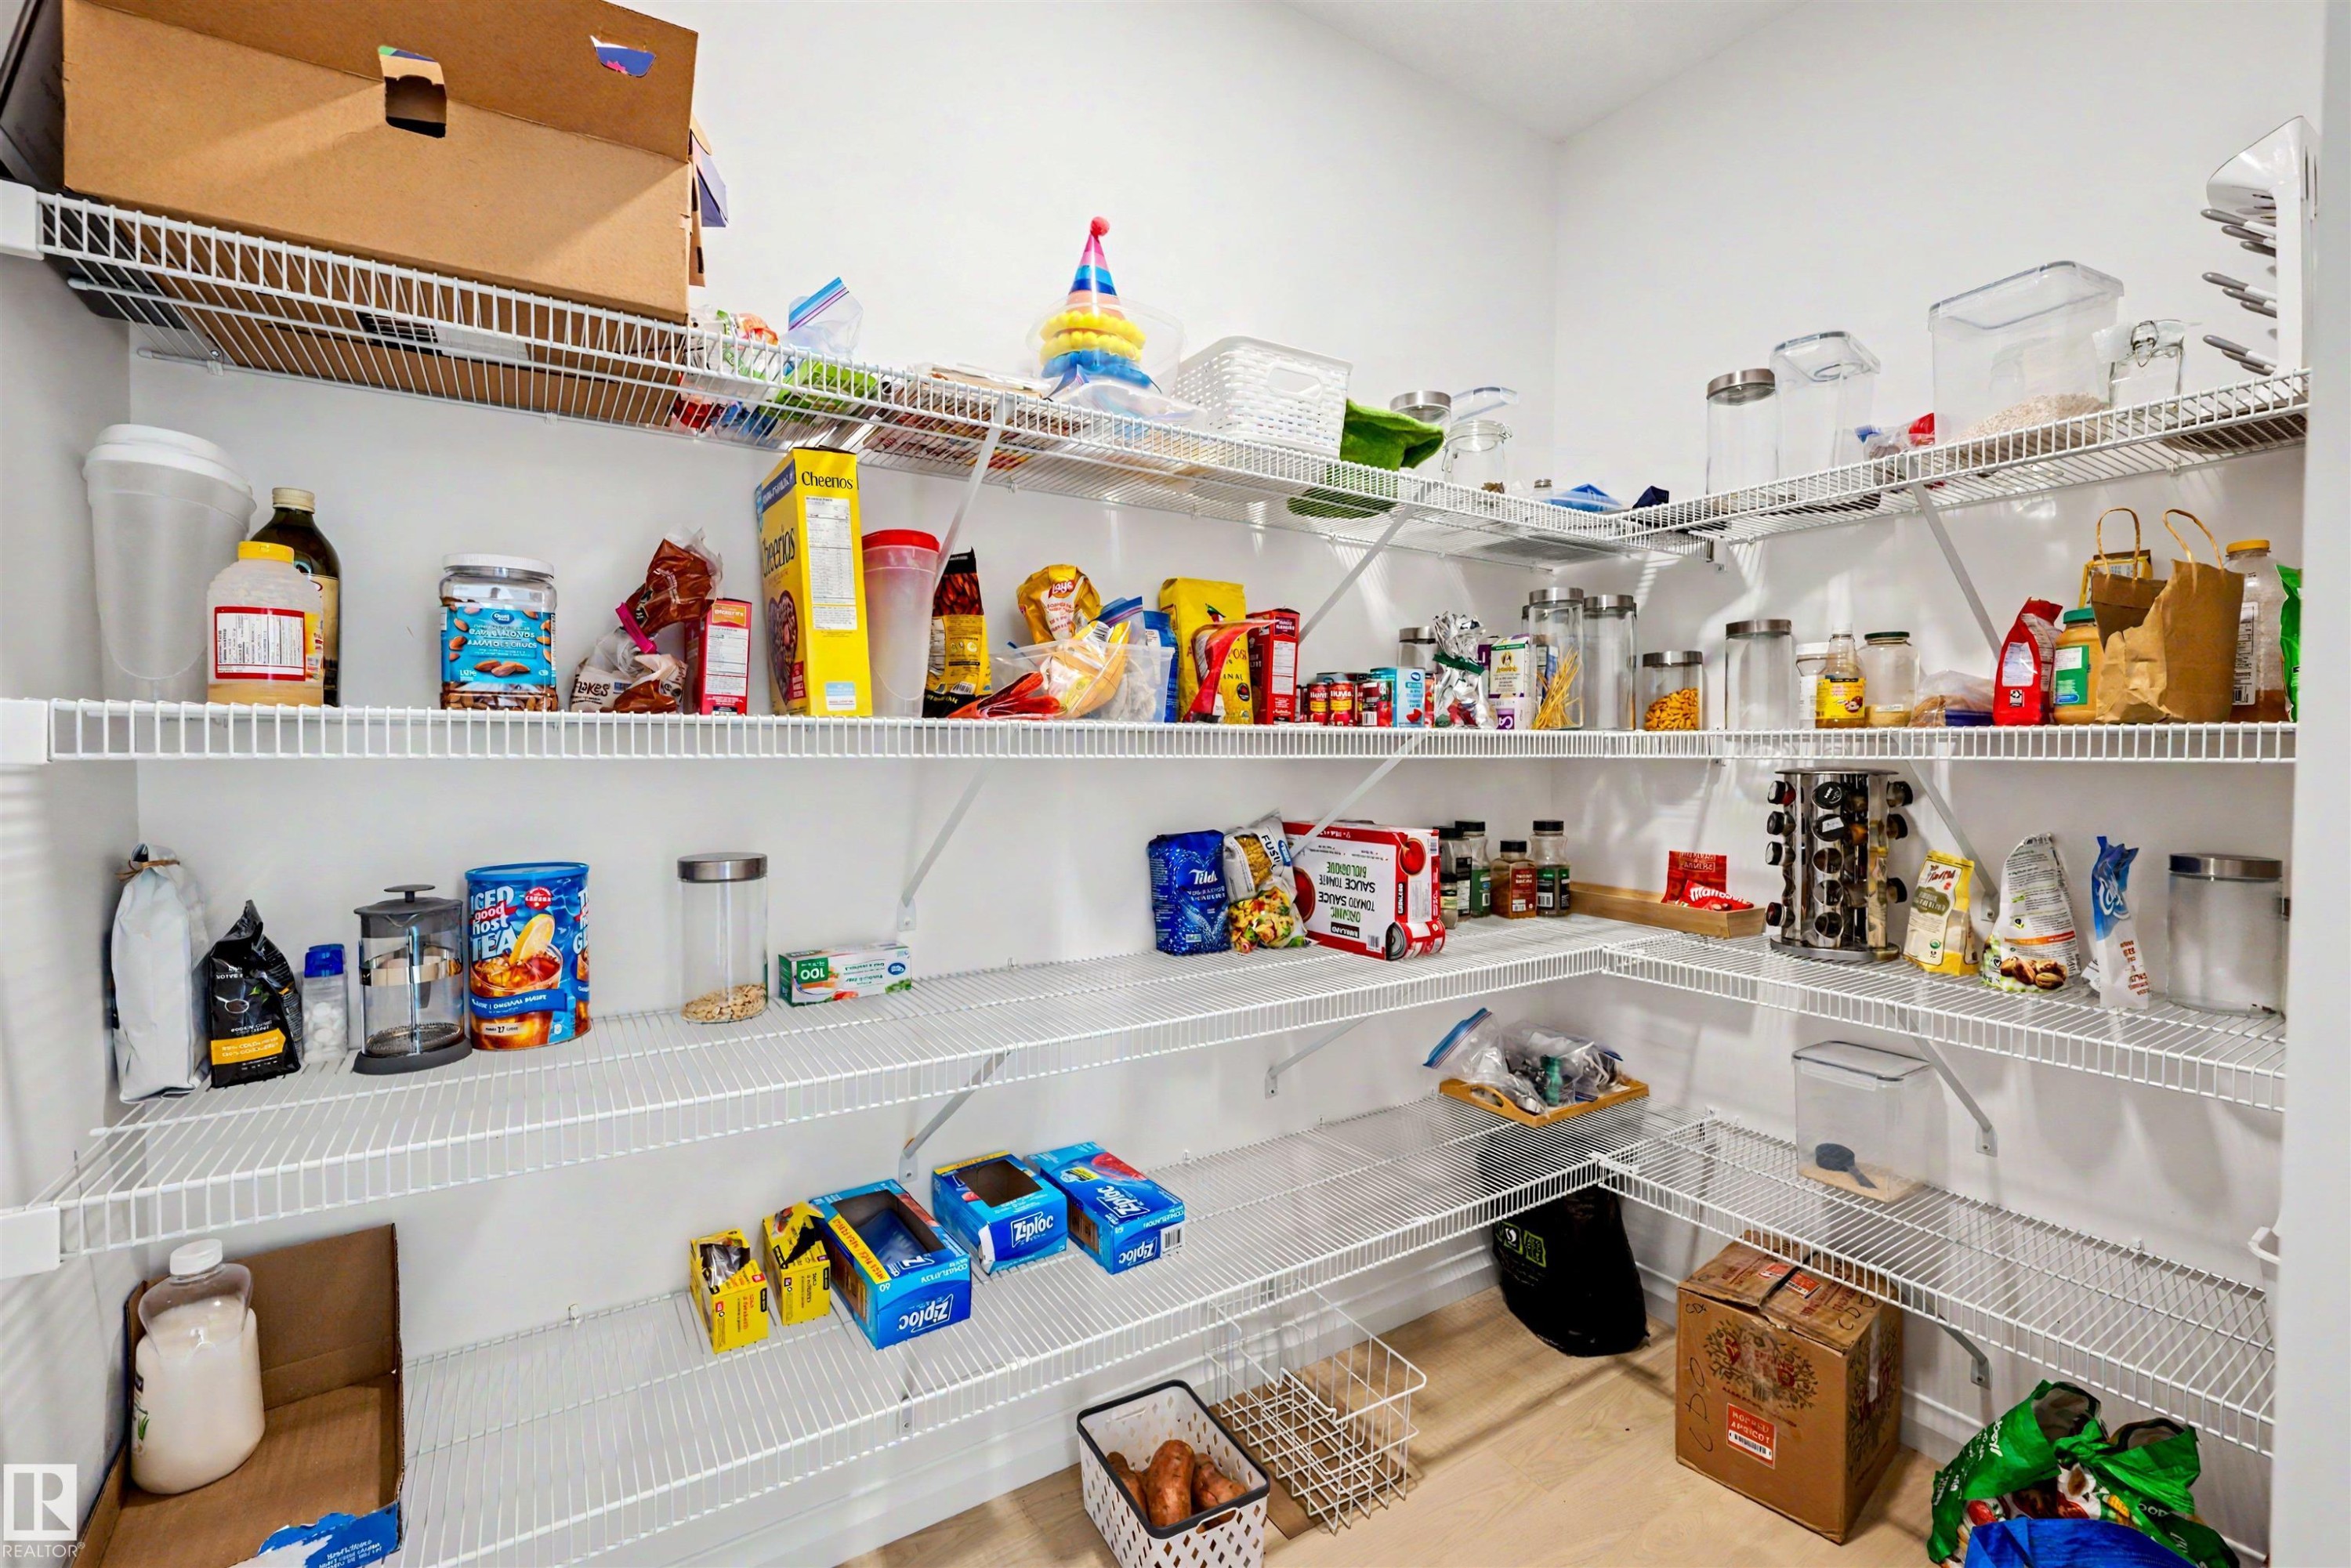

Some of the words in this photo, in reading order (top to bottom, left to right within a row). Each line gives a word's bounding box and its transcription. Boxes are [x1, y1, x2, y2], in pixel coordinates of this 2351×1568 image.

[1345, 878, 1375, 893] SAUCE
[1318, 891, 1346, 905] SAUCE
[475, 906, 505, 922] good
[473, 915, 509, 936] host
[471, 925, 518, 961] TEA
[800, 968, 825, 980] 100
[1096, 1185, 1141, 1215] Ziploc
[1014, 1215, 1054, 1241] Ziploc
[1118, 1240, 1154, 1264] Ziploc
[879, 1283, 891, 1292] 60
[897, 1300, 949, 1331] Ziploc
